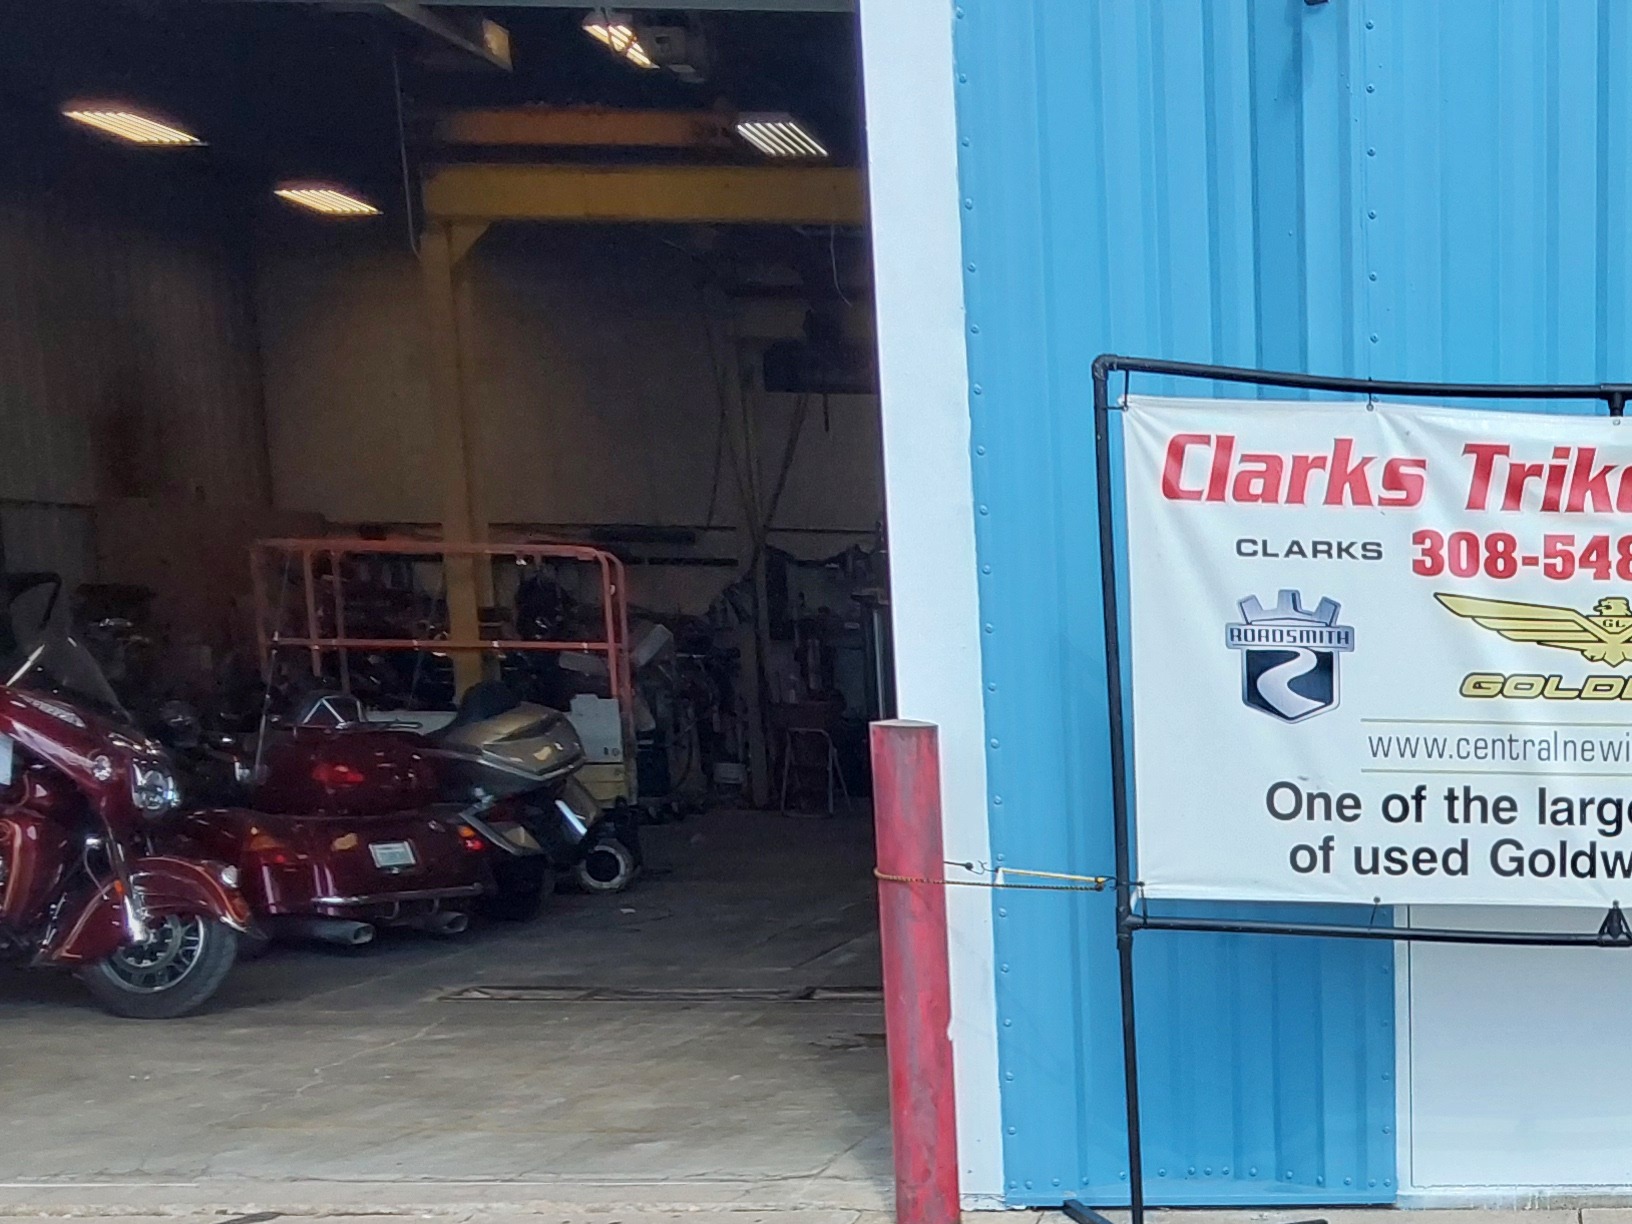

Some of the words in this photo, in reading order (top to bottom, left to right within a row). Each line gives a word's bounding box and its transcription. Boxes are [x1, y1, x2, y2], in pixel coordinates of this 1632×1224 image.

[1161, 433, 1427, 507] Clarks
[1235, 538, 1383, 561] CLARKS
[1229, 626, 1351, 645] ROADSMITH
[1601, 617, 1626, 630] GL
[1265, 780, 1362, 823] One
[1381, 784, 1427, 824] of
[1443, 785, 1518, 825] the
[1289, 835, 1335, 874] of
[1354, 838, 1469, 877] used
